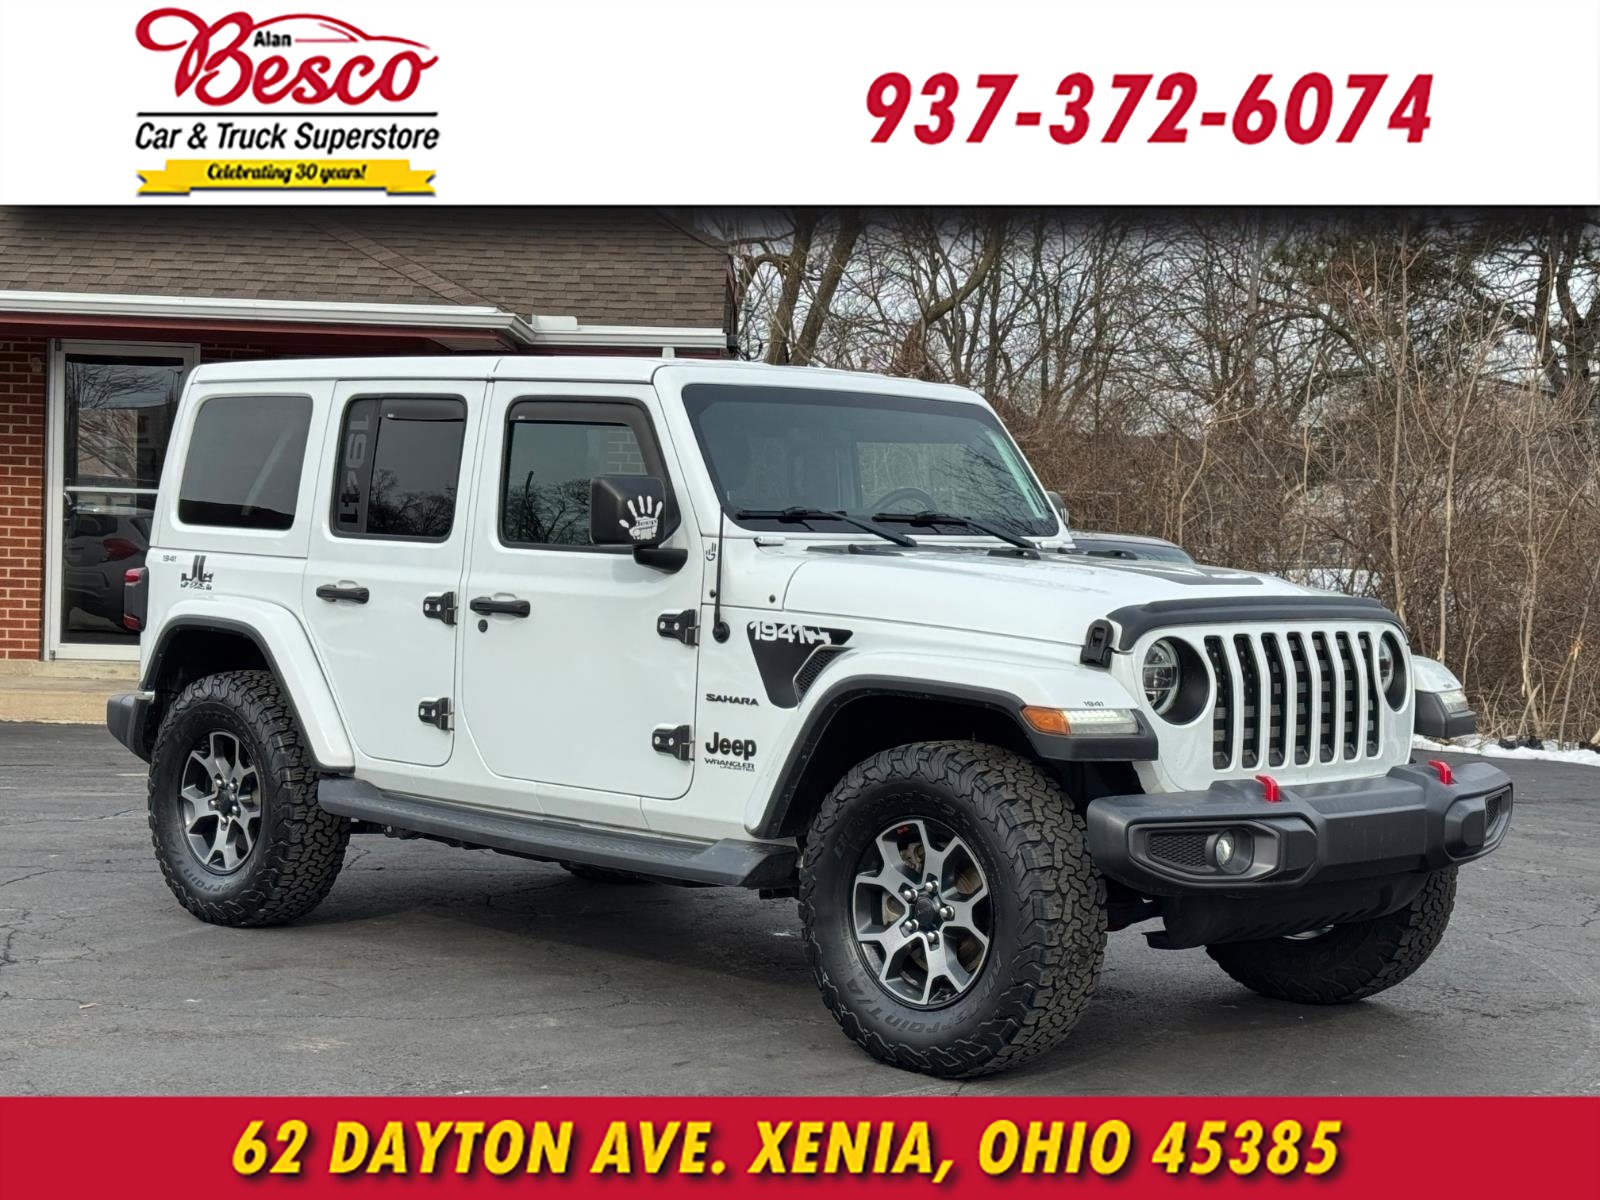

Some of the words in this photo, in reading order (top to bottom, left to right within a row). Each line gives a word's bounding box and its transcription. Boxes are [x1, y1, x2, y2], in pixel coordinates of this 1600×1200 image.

[749, 621, 807, 644] 1941
[706, 693, 759, 706] SAHARA
[705, 732, 757, 760] Jeep
[704, 758, 755, 769] WRANGLER
